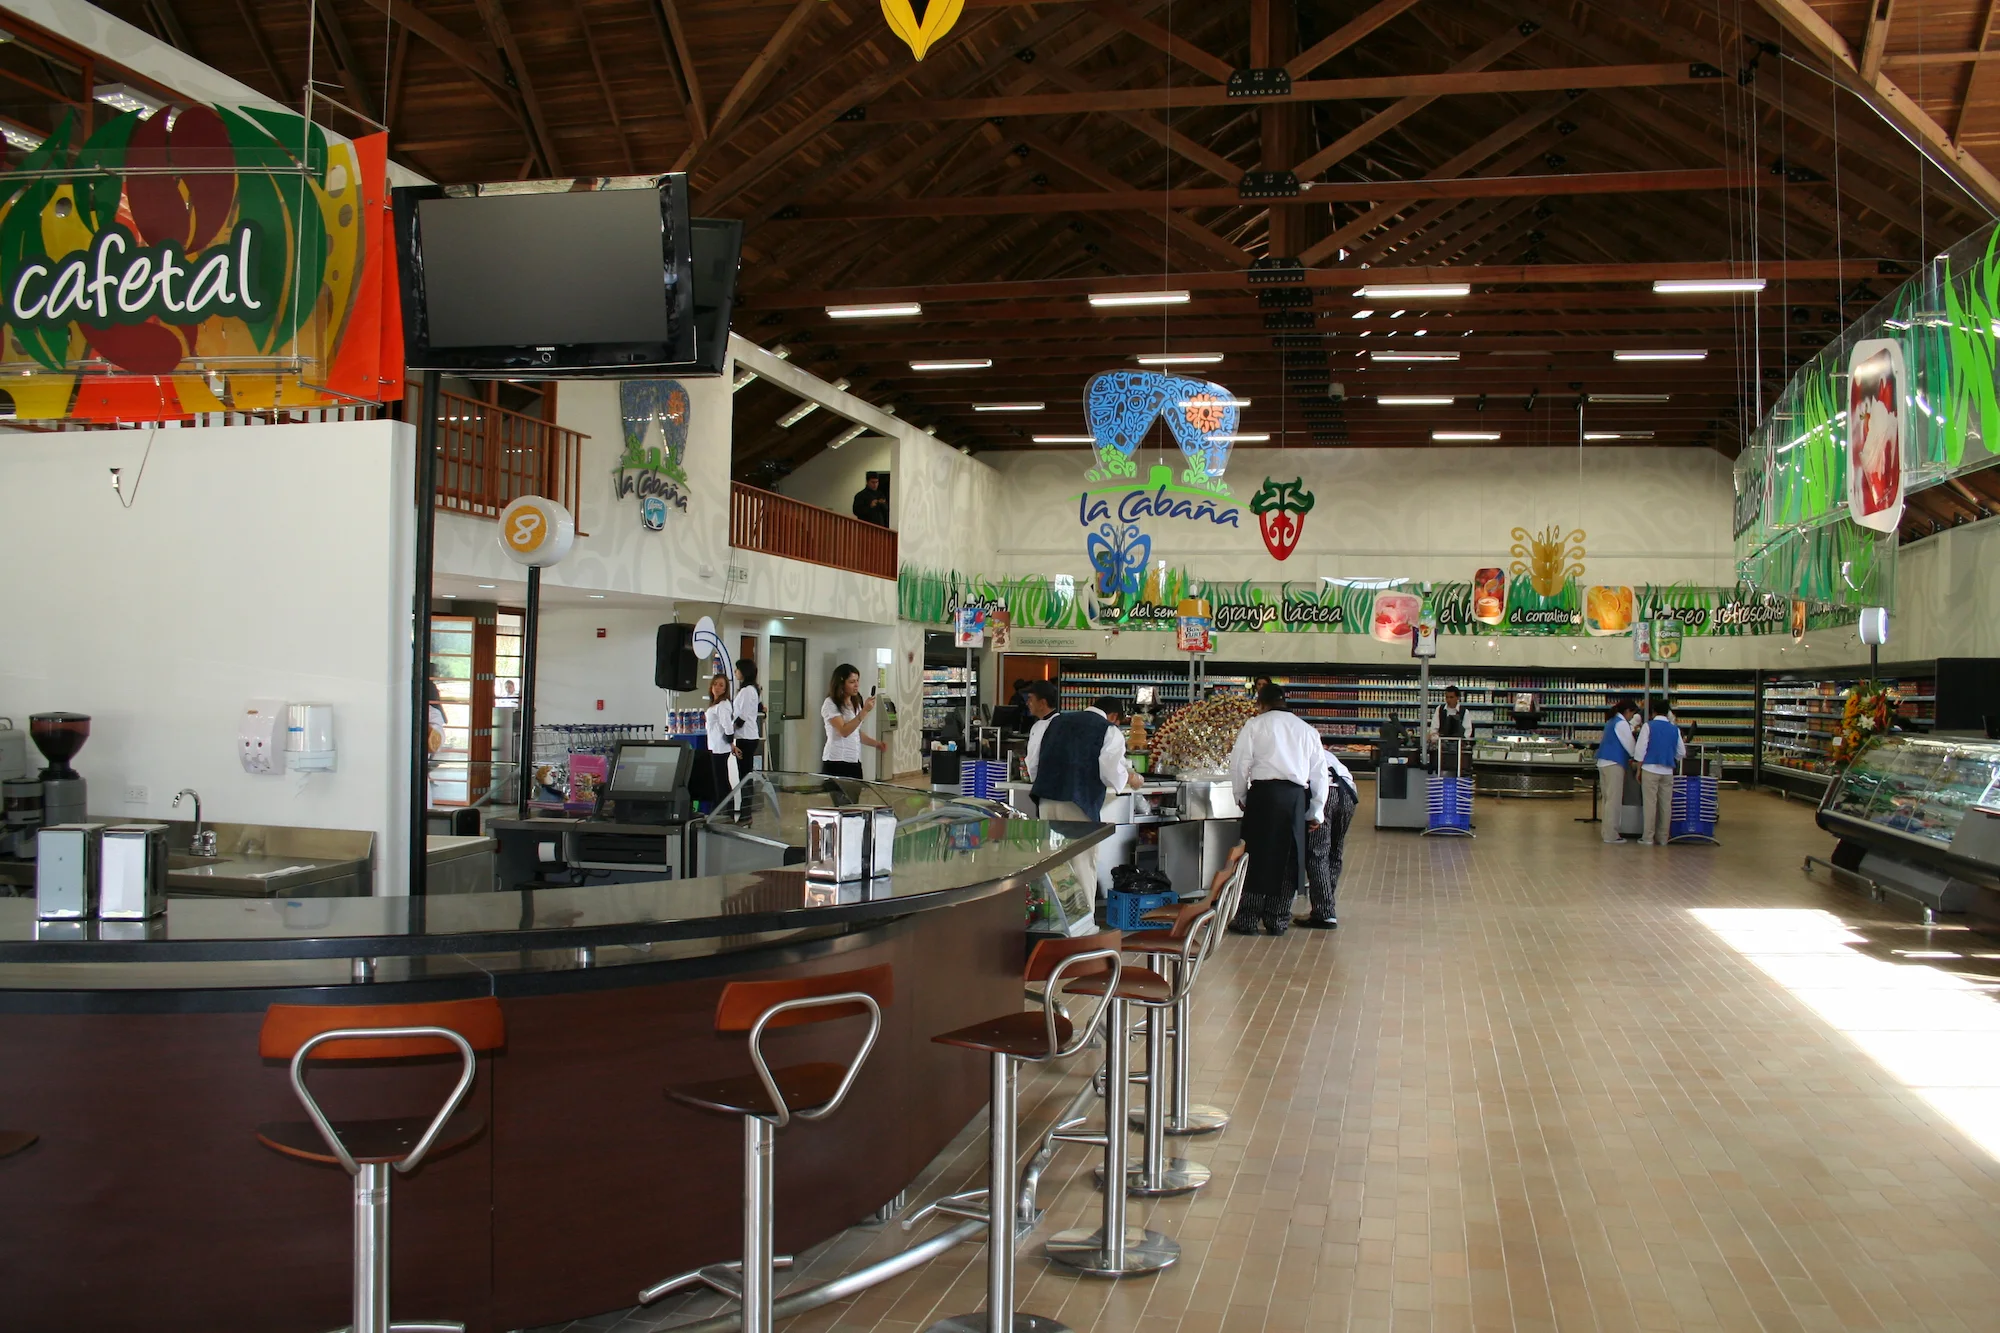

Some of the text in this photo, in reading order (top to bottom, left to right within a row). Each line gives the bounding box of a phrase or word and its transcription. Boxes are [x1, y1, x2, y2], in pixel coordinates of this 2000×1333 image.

[14, 228, 262, 320] cafetal
[1118, 484, 1240, 529] Cabaña
[948, 593, 958, 613] el
[1130, 602, 1151, 618] del
[1440, 602, 1458, 623] el
[1717, 600, 1787, 625] refrescante
[1217, 600, 1343, 630] granja láctea
[1510, 608, 1523, 623] el
[1526, 608, 1569, 624] corralito
